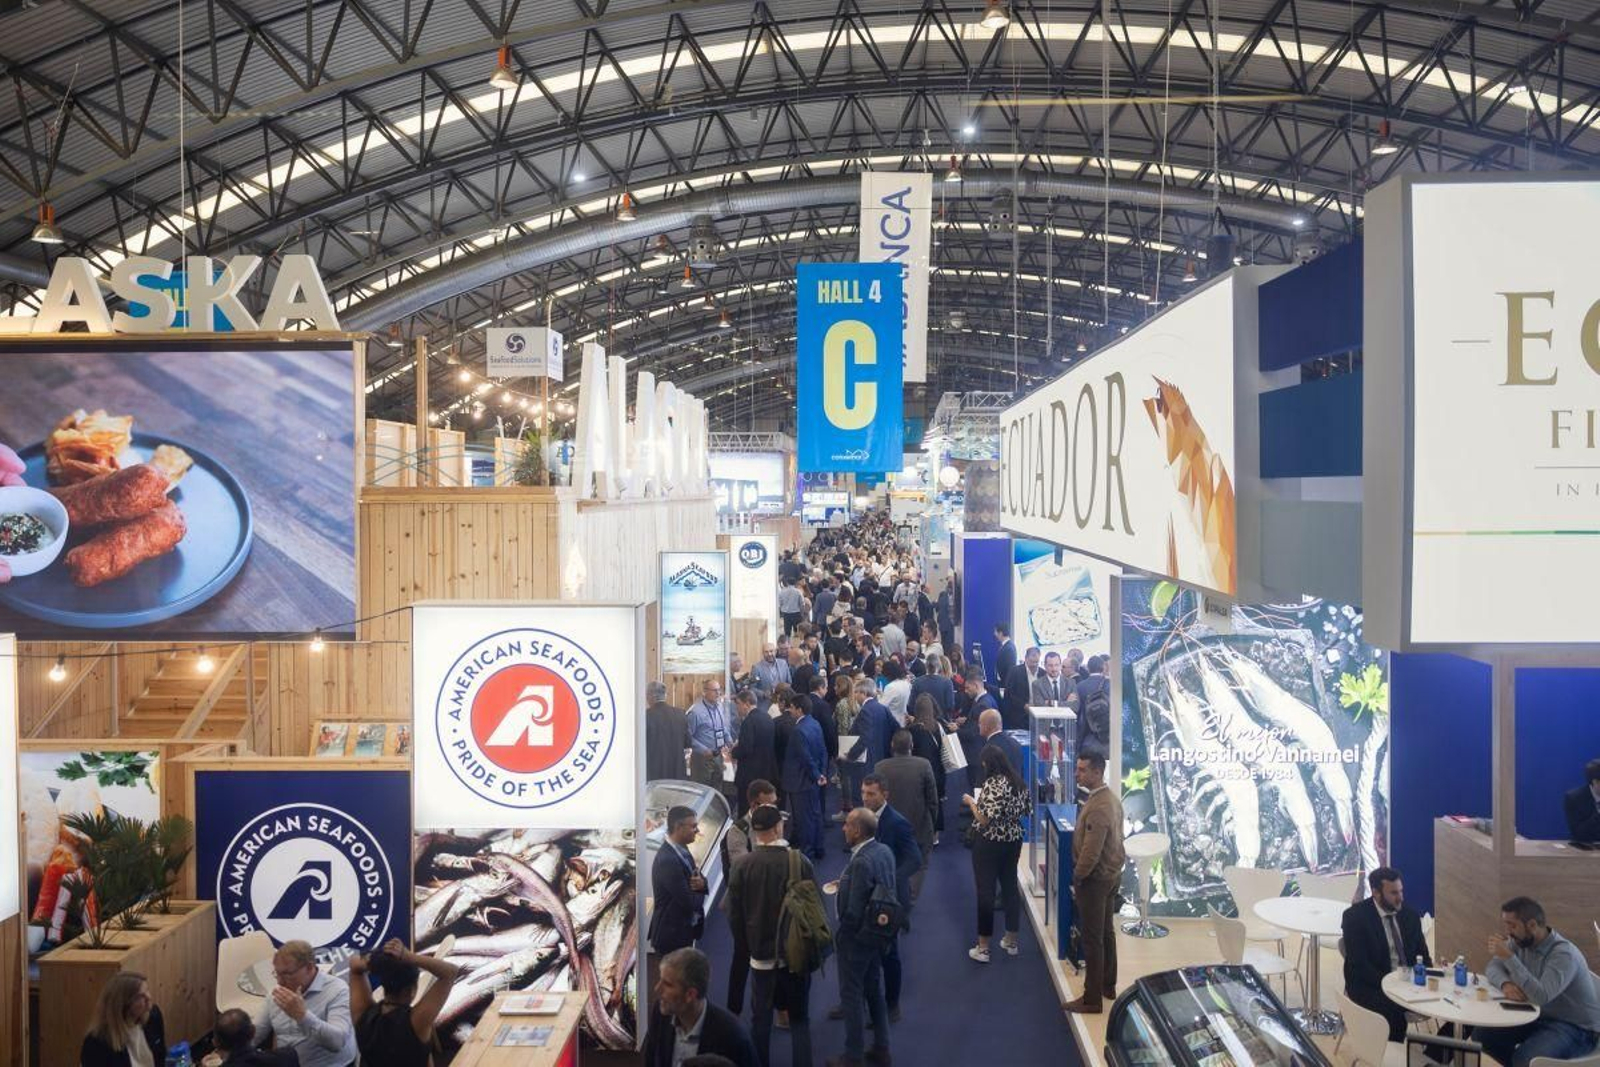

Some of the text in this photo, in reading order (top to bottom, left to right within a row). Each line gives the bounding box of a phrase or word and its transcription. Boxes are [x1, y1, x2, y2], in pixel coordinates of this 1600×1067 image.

[0, 254, 342, 332] ASKA
[818, 279, 882, 304] HALL 4
[823, 319, 877, 431] C
[1495, 290, 1600, 386] E
[1001, 371, 1136, 536] ECUADOR
[448, 640, 605, 723] AMERICAN SEAFOODS
[452, 739, 601, 797] PRIDE OF THE SEA
[1149, 744, 1360, 765] Langostino Vannamei
[1216, 767, 1257, 780] DESDE
[228, 815, 383, 898] AMERICAN SEAFOODS
[352, 913, 380, 948] SEA
